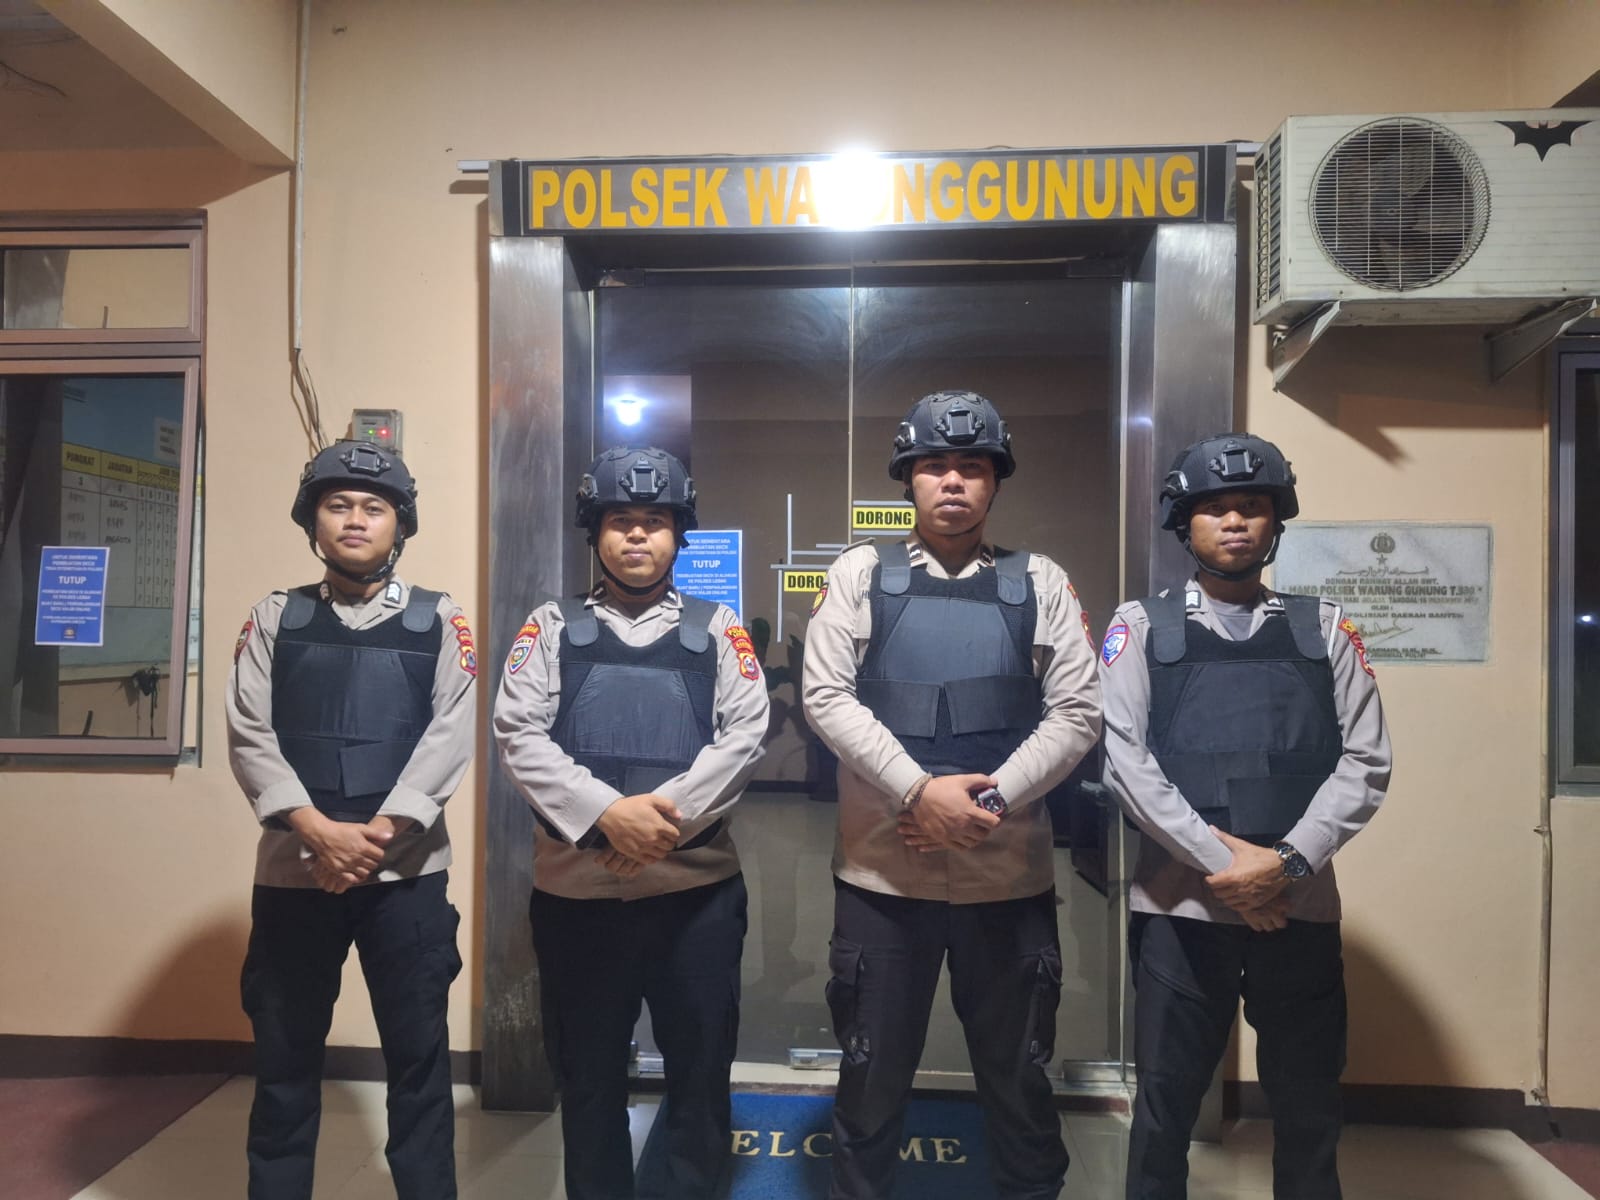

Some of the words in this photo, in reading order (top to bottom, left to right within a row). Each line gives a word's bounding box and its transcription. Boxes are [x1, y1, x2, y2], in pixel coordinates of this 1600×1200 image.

[532, 168, 728, 228] POLSEK
[745, 154, 1196, 226] WANGGUNUNG
[856, 511, 912, 525] DORONG
[692, 560, 721, 569] TUTUP
[58, 575, 87, 585] TUTUP
[788, 575, 824, 588] DORO
[1288, 585, 1318, 596] MAKO
[1320, 585, 1356, 596] POLSEK
[1358, 585, 1403, 596] WARUNG
[1405, 585, 1448, 596] GUNUNG
[731, 1130, 967, 1163] ELCME
